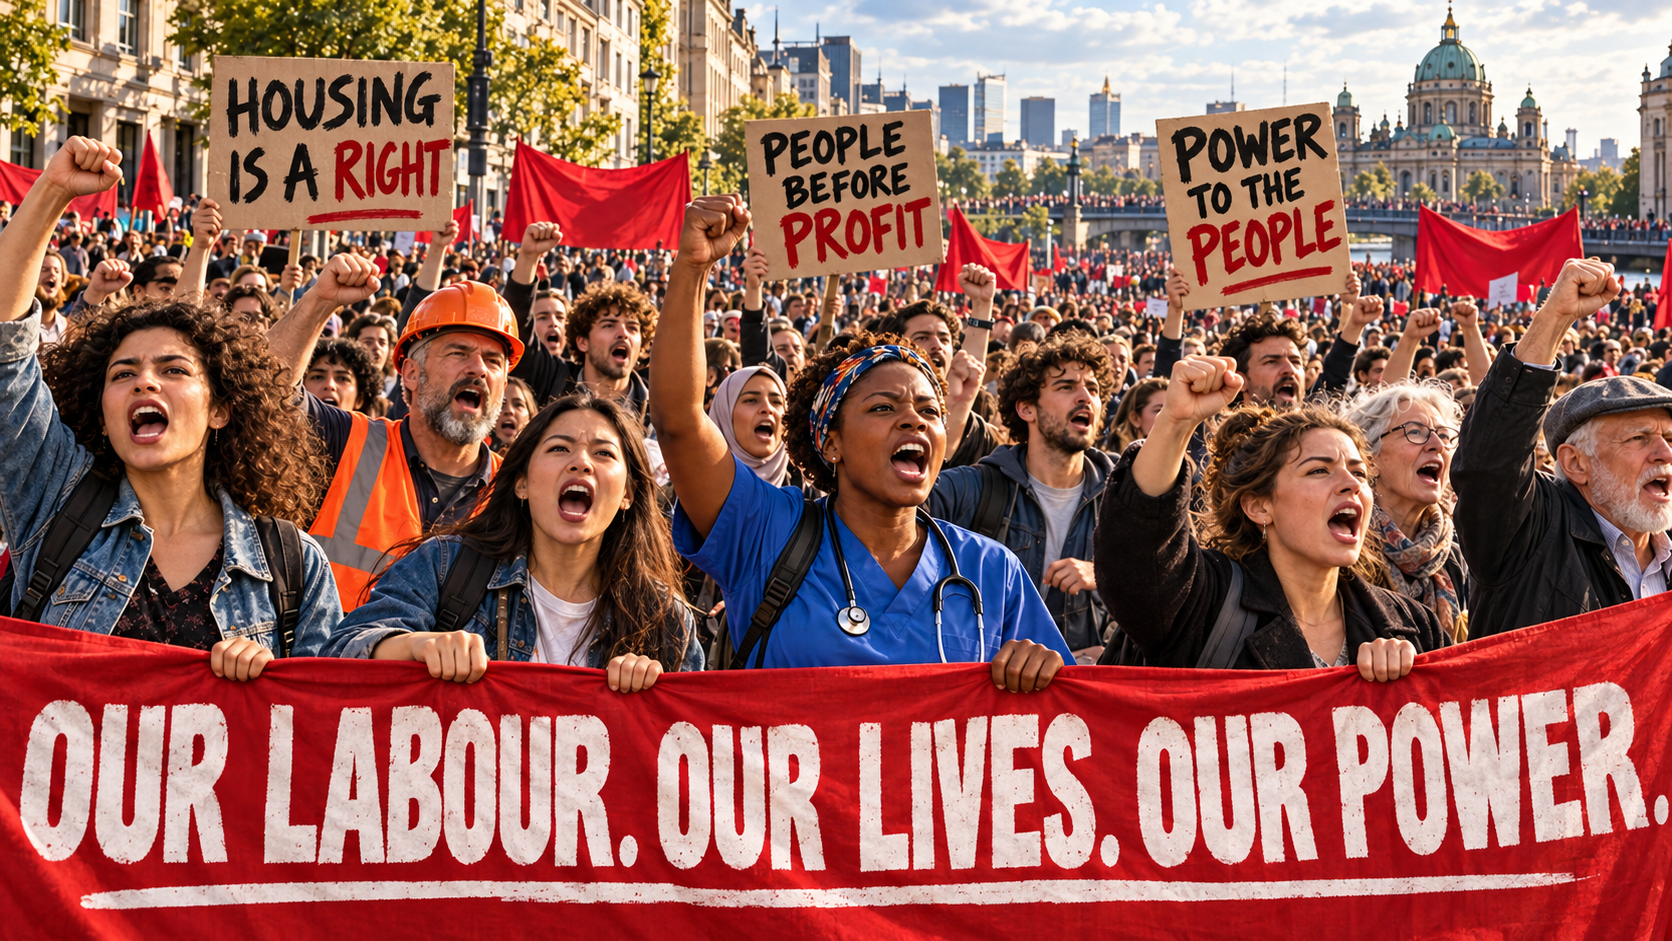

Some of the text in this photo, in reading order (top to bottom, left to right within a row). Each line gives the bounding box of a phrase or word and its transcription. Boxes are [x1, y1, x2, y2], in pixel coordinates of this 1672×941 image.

[226, 71, 441, 138] HOUSING
[229, 138, 451, 204] IS A RIGHT
[760, 121, 906, 177] PEOPLE
[1171, 113, 1329, 183] POWER
[782, 162, 911, 209] BEFORE
[1187, 167, 1305, 218] TO THE
[780, 197, 931, 269] PROFIT
[1187, 200, 1342, 286] PEOPLE
[20, 681, 1670, 872] OUR LABOUR. OUR LIVES. OUR POWER.
